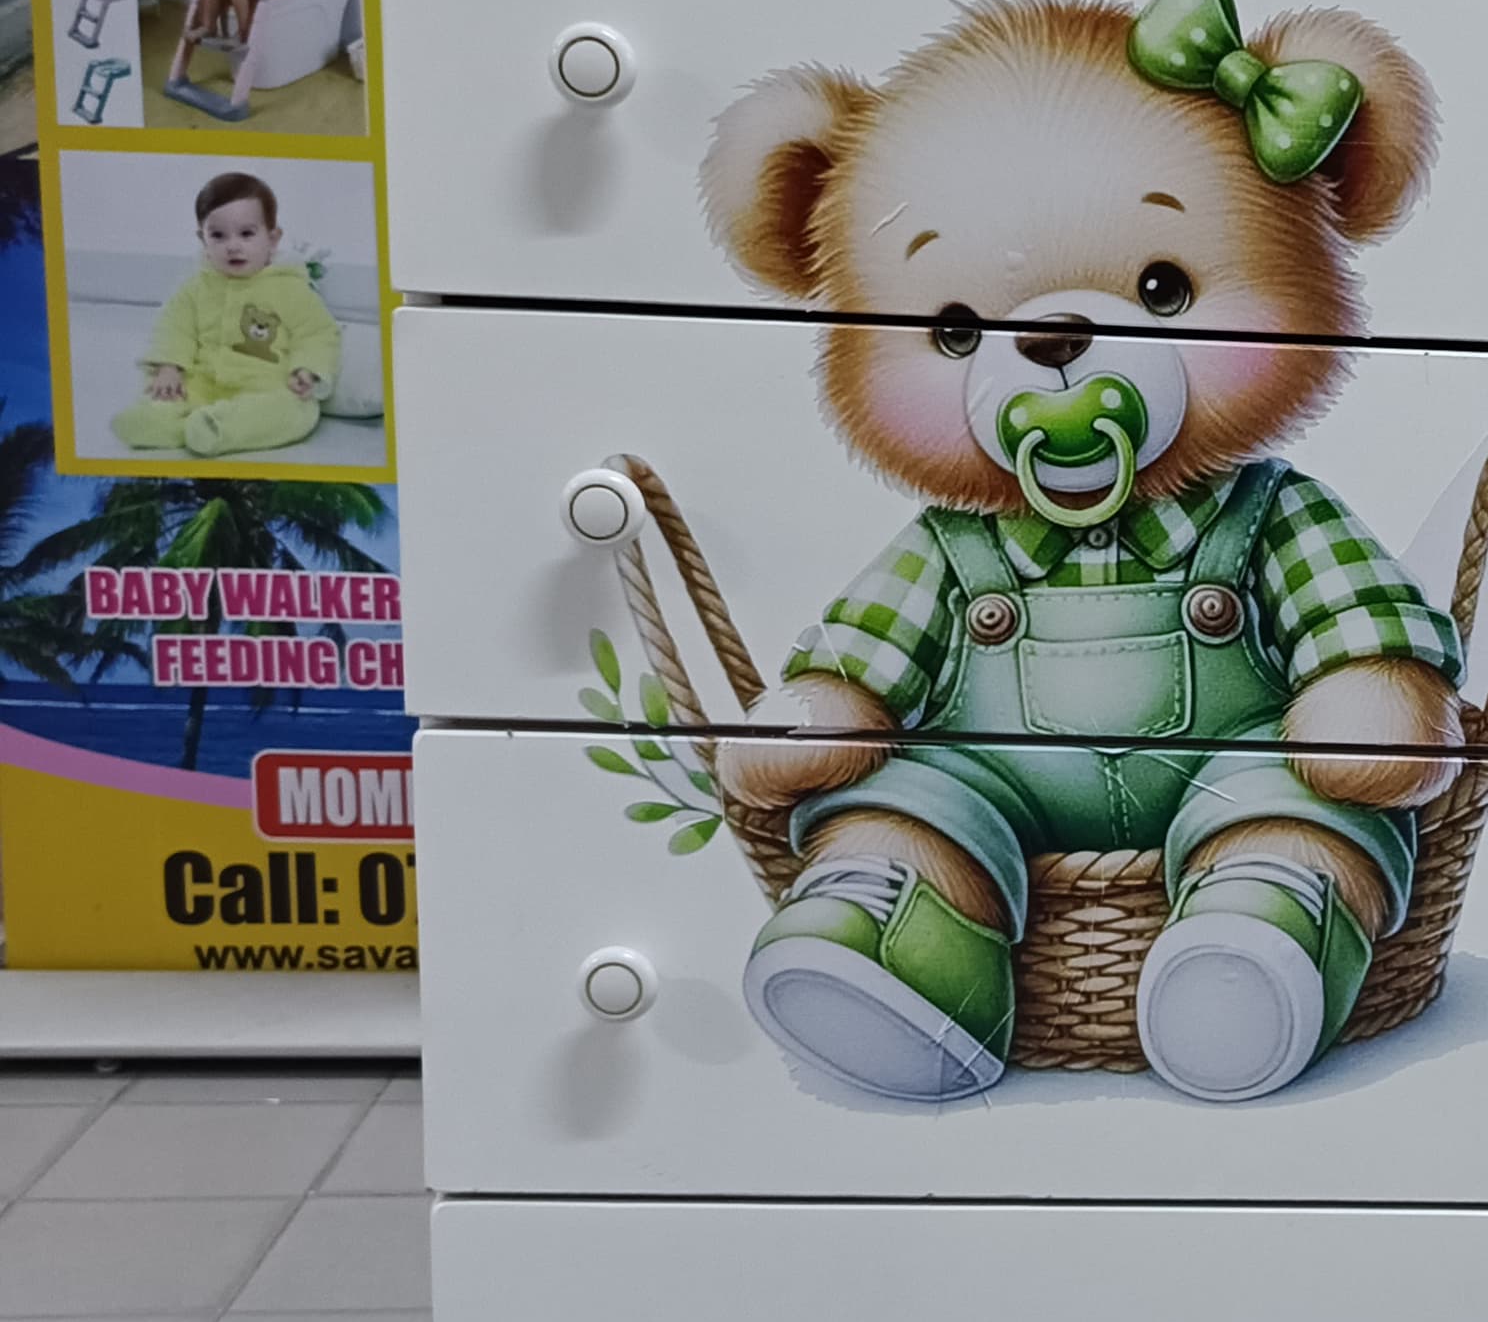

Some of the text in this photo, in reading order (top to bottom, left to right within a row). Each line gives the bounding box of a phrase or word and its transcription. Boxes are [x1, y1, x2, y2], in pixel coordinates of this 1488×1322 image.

[87, 568, 400, 621] BABY WALKER
[155, 637, 338, 686] FEEDING
[163, 850, 418, 926] Call: 0
[194, 945, 418, 970] www.sava
